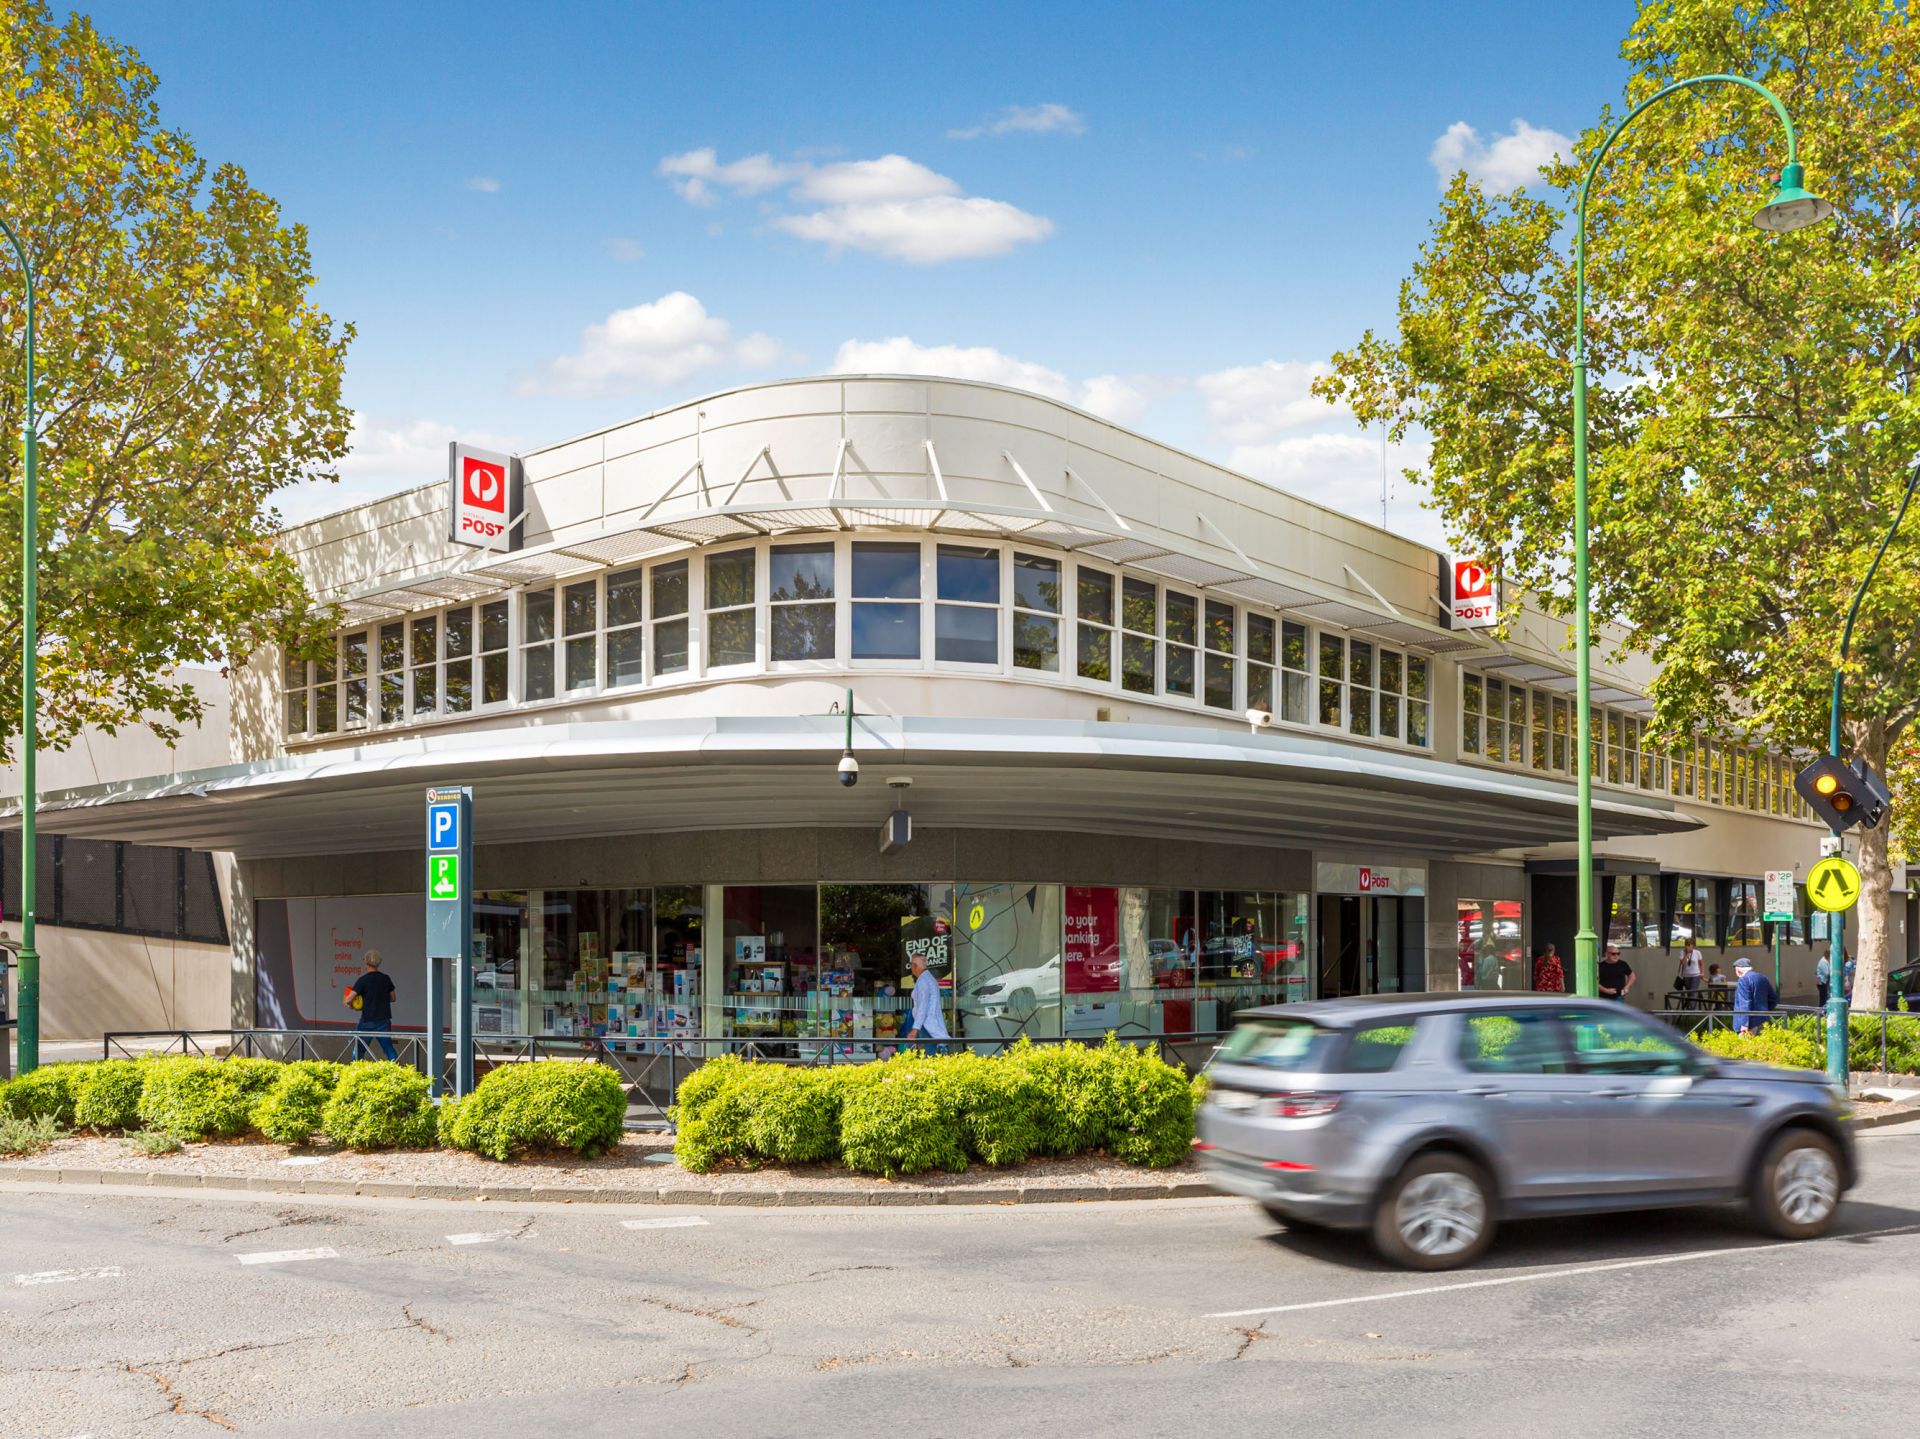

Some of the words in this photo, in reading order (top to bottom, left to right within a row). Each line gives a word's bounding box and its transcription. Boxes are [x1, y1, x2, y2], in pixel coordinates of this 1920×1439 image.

[462, 516, 504, 537] POST
[1455, 606, 1492, 619] POST
[435, 811, 452, 843] P
[438, 859, 449, 877] P
[1371, 877, 1390, 888] POST
[1076, 915, 1098, 929] your
[905, 938, 930, 951] END
[932, 934, 948, 947] OF
[1065, 931, 1100, 947] anking
[1066, 951, 1085, 962] ere.
